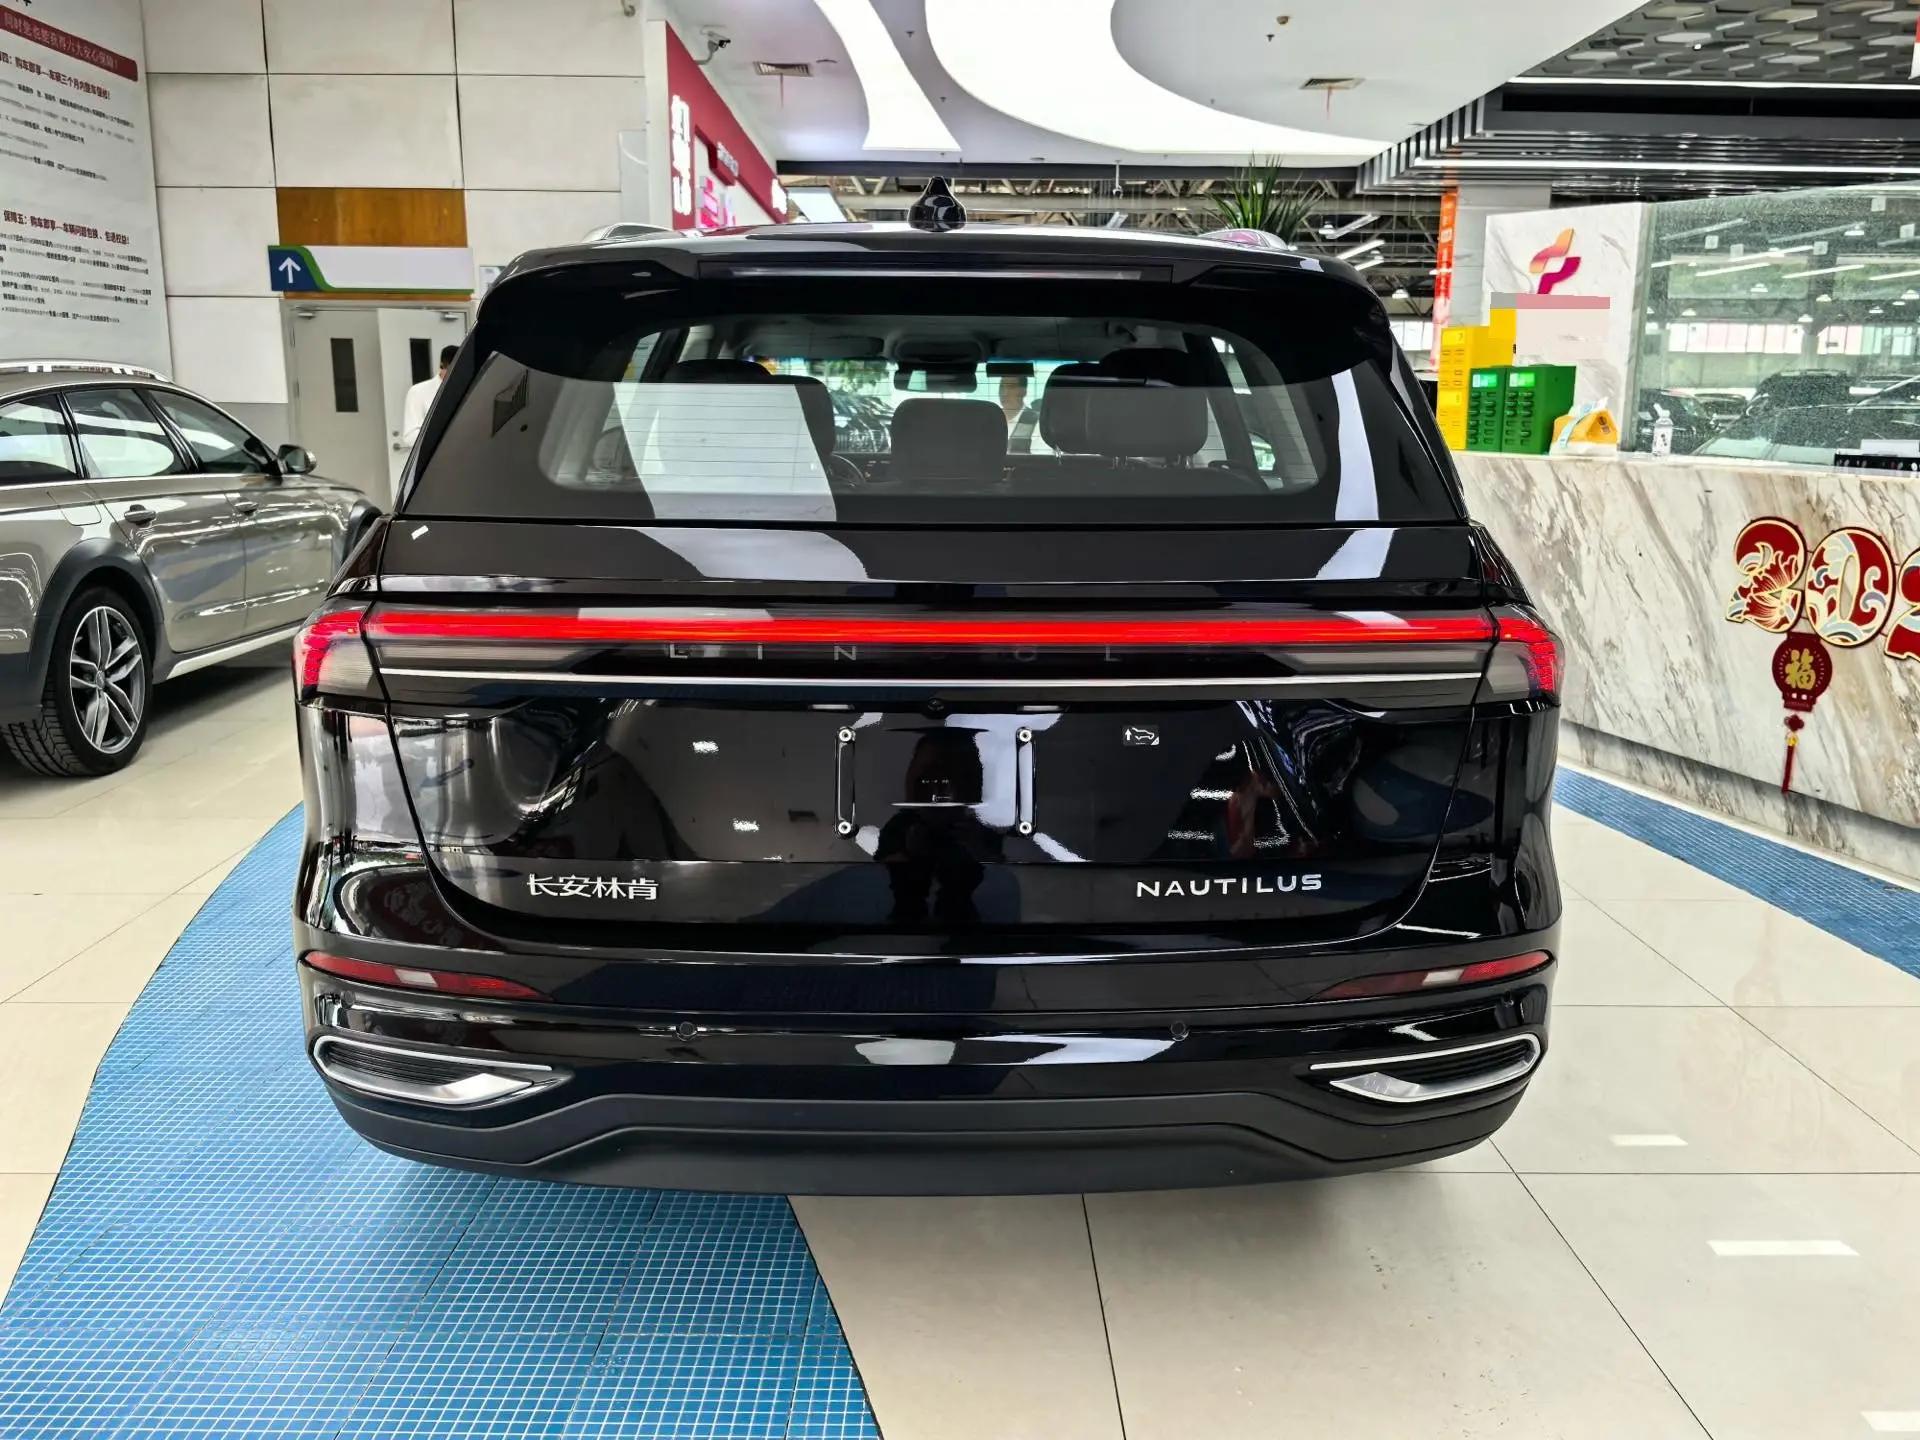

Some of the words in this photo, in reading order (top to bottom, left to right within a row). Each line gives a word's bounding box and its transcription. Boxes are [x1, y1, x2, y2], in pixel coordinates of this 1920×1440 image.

[1785, 648, 1816, 690] 福
[527, 873, 659, 900] 长安林肯
[1136, 873, 1322, 897] NAUTILUS
